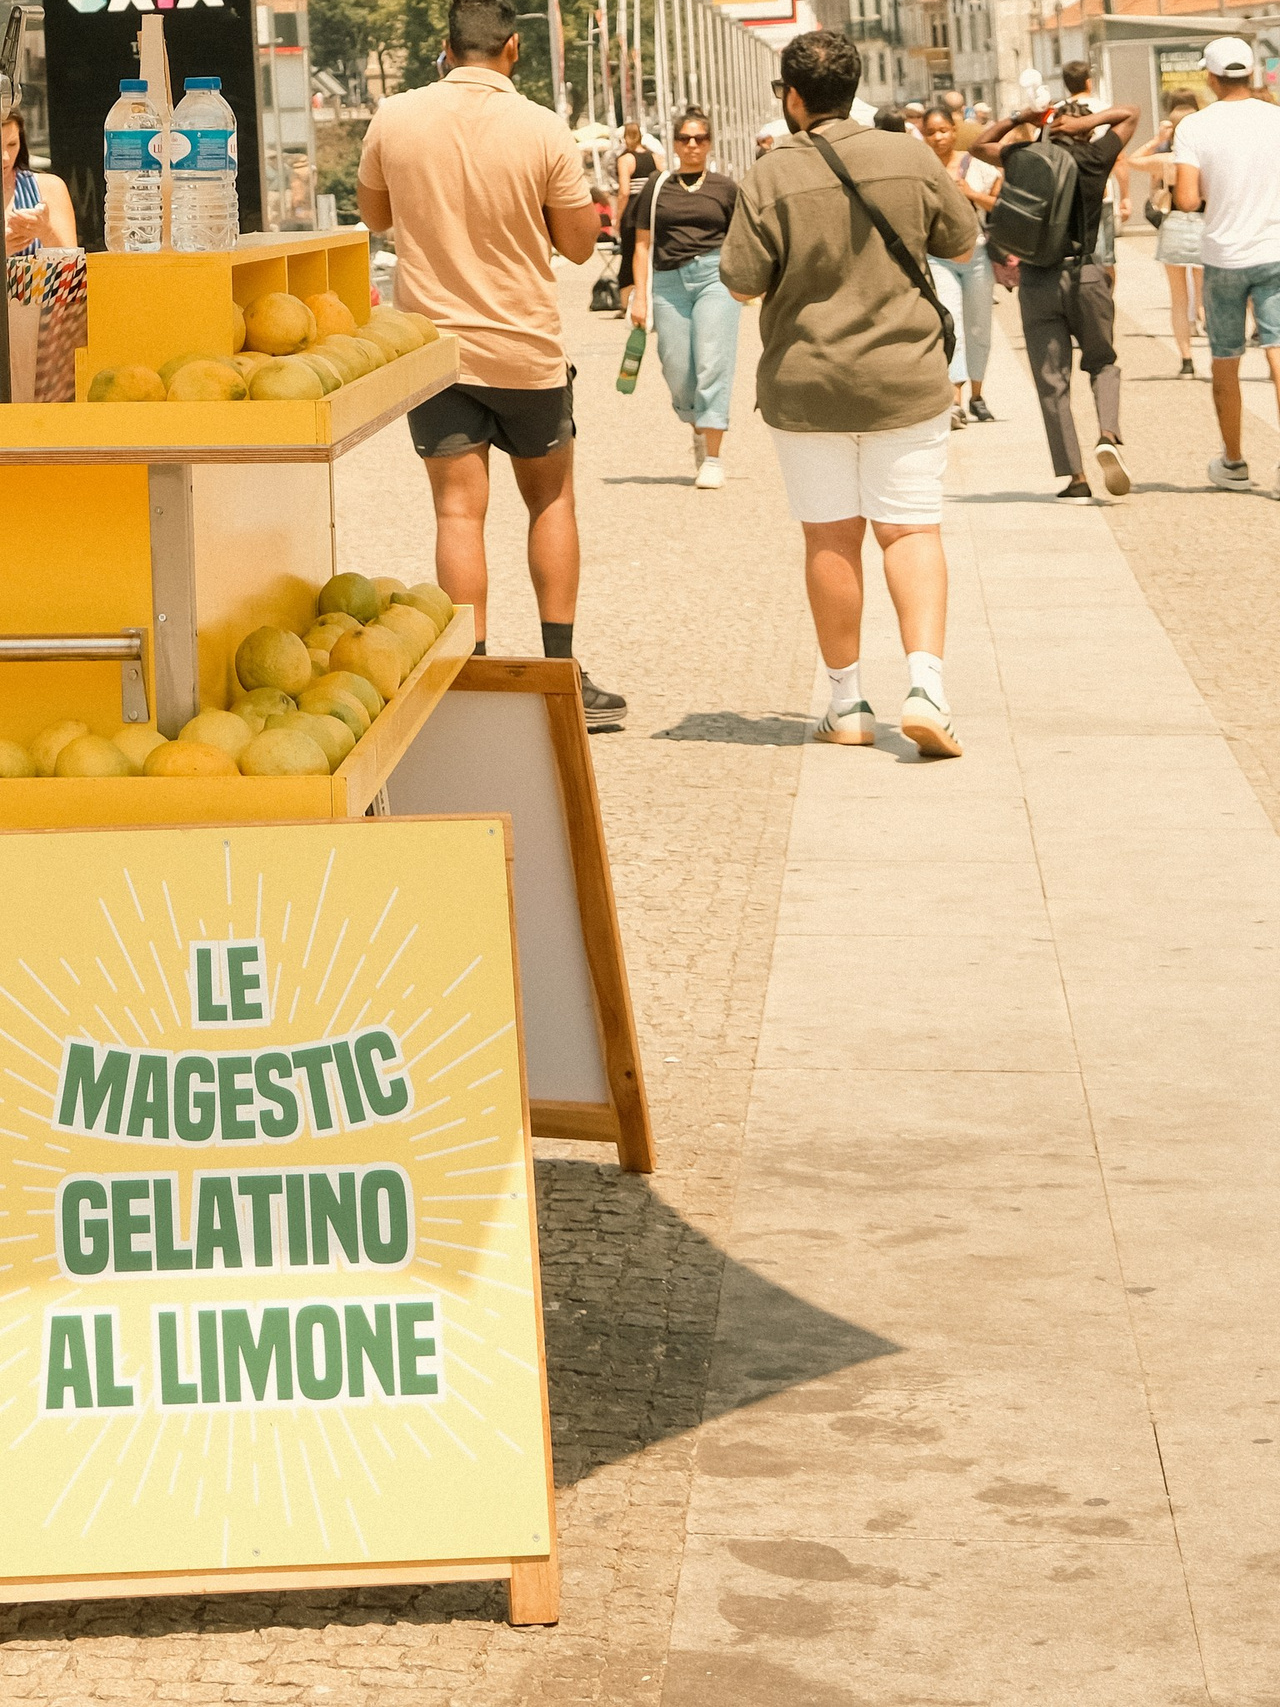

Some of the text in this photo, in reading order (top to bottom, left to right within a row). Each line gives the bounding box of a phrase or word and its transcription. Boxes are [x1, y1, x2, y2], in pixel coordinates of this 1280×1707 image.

[197, 946, 261, 1021] LE
[59, 1030, 408, 1142] MAGESTIC
[62, 1169, 409, 1276] GELATINO
[46, 1302, 438, 1409] AL LIMONE
